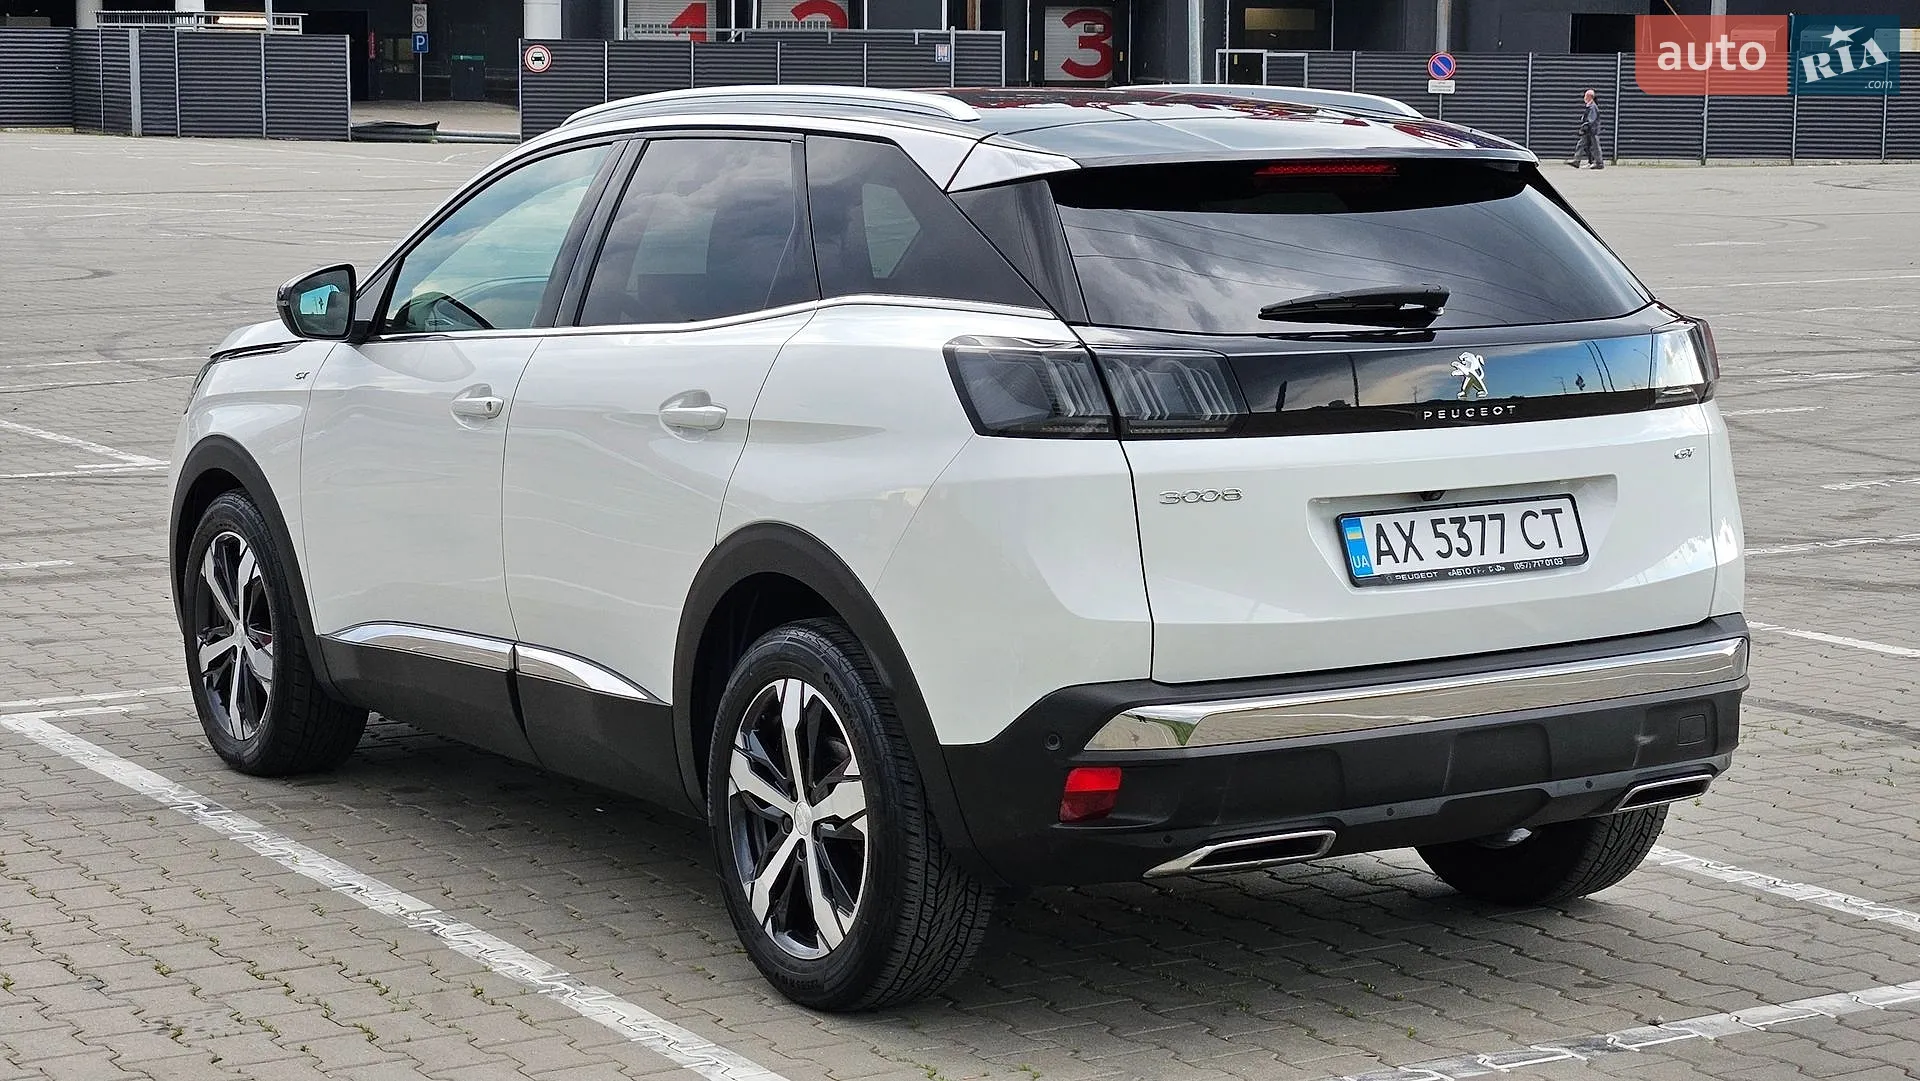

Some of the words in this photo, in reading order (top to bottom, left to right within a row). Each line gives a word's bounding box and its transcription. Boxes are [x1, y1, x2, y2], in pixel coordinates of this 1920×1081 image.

[416, 35, 425, 50] P
[1061, 8, 1113, 79] 3
[1423, 405, 1516, 420] PEUGEOT
[1159, 487, 1242, 505] 3008
[1376, 520, 1425, 566] AX
[1430, 513, 1506, 559] 5377
[1520, 507, 1564, 550] CT
[1352, 554, 1370, 569] UA
